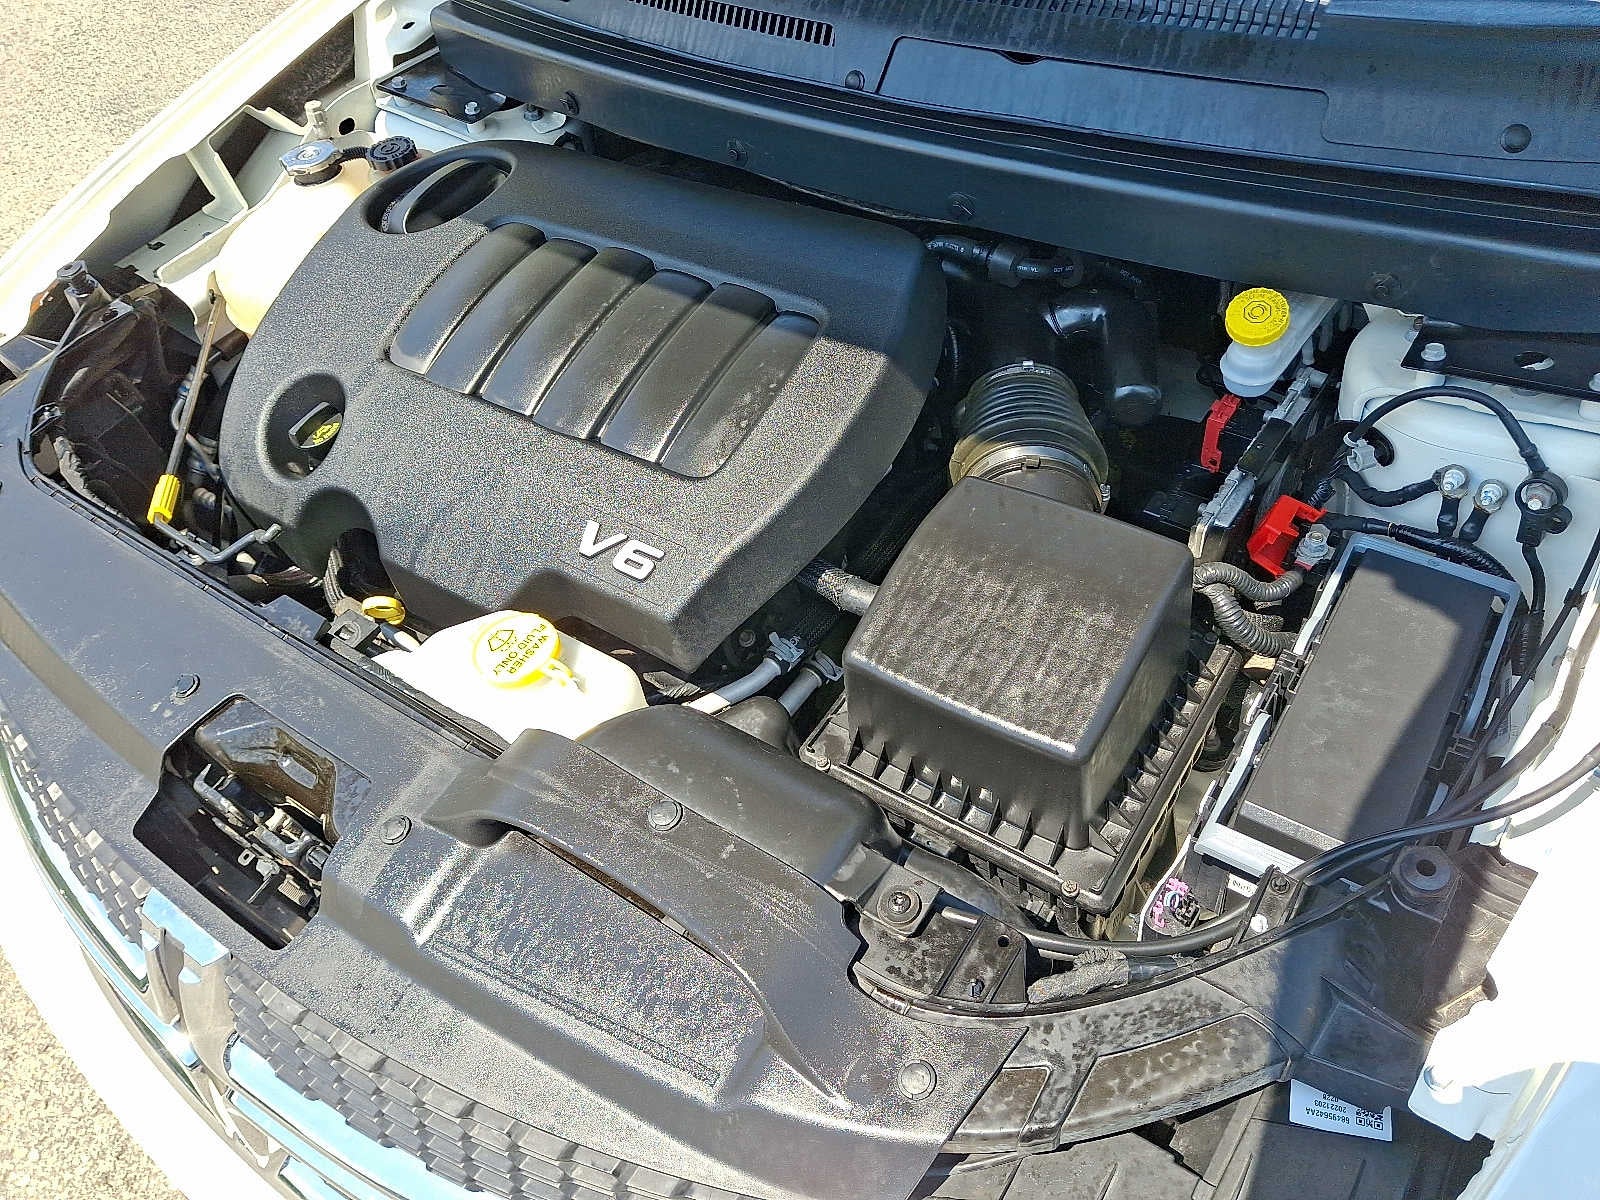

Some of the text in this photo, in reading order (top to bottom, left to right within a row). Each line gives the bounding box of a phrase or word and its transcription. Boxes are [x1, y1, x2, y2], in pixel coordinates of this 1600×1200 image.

[579, 519, 665, 582] V6
[493, 623, 547, 675] FLUID ONLY
[507, 635, 548, 674] WASHER
[1314, 1099, 1347, 1113] 20221203
